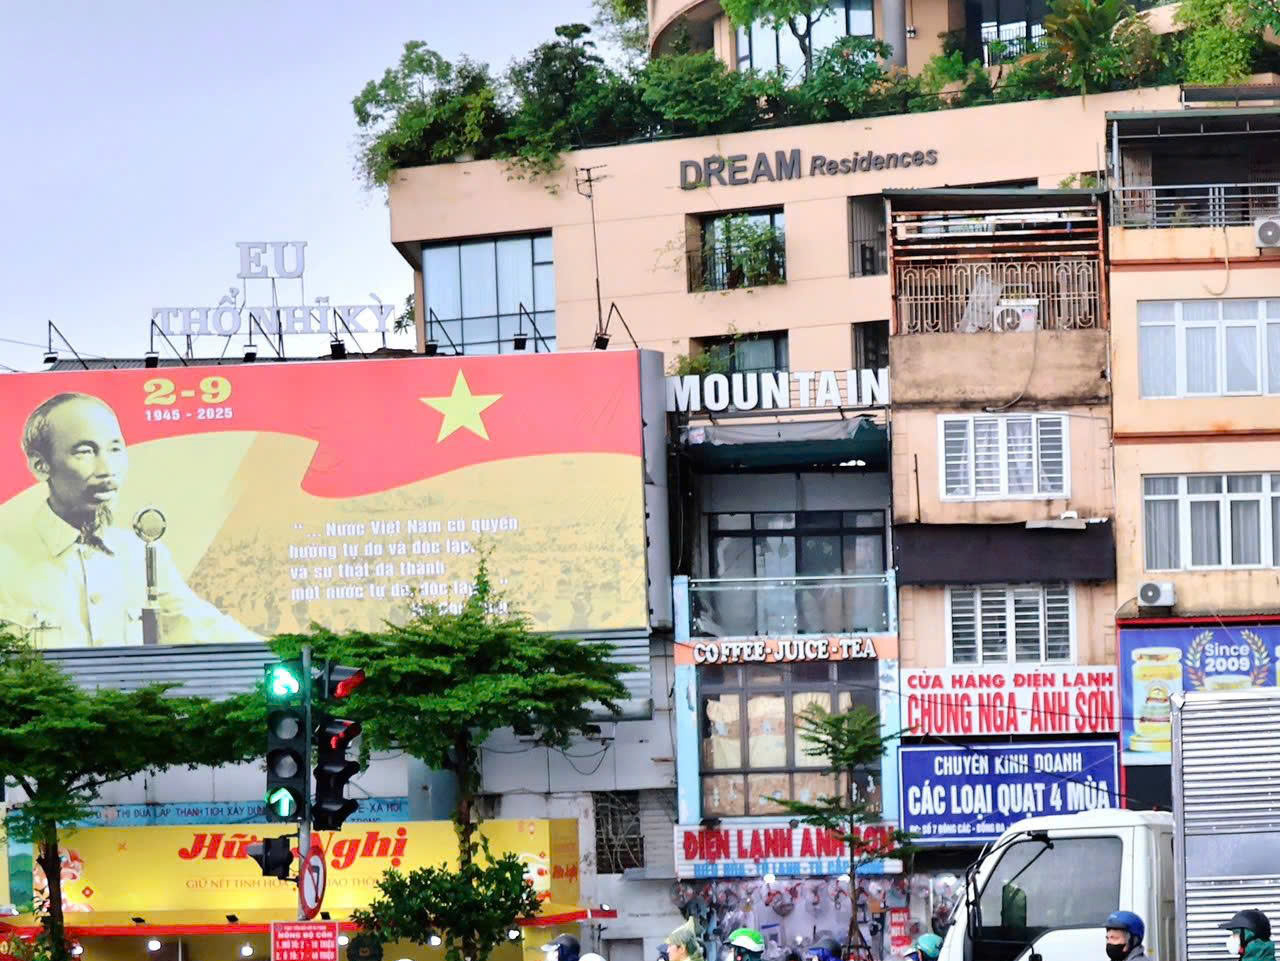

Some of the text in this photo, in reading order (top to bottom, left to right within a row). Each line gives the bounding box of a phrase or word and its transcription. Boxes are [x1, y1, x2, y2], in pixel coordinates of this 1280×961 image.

[680, 149, 938, 190] DREAM Residences
[236, 241, 307, 279] EU
[152, 287, 395, 337] THỔ NHĨ KỲ
[665, 367, 890, 412] MOUNTAIN
[145, 407, 233, 421] 1945 2025
[407, 518, 441, 536] Nam
[1204, 642, 1250, 657] Since
[1204, 656, 1251, 673] 2009
[907, 669, 944, 689] CỬA
[951, 669, 1006, 689] HÀNG
[1013, 668, 1055, 691] ĐIỆN
[907, 692, 973, 735] CHUNG
[978, 691, 1019, 733] NGA
[1075, 687, 1114, 733] SƠN
[934, 753, 989, 777] CHUYÊN
[1034, 751, 1083, 774] DOANH
[908, 774, 1111, 821] CÁC LOẠI QUẠT 4 MÙA
[683, 829, 731, 864] ĐIỆN
[736, 827, 793, 863] LẠNH
